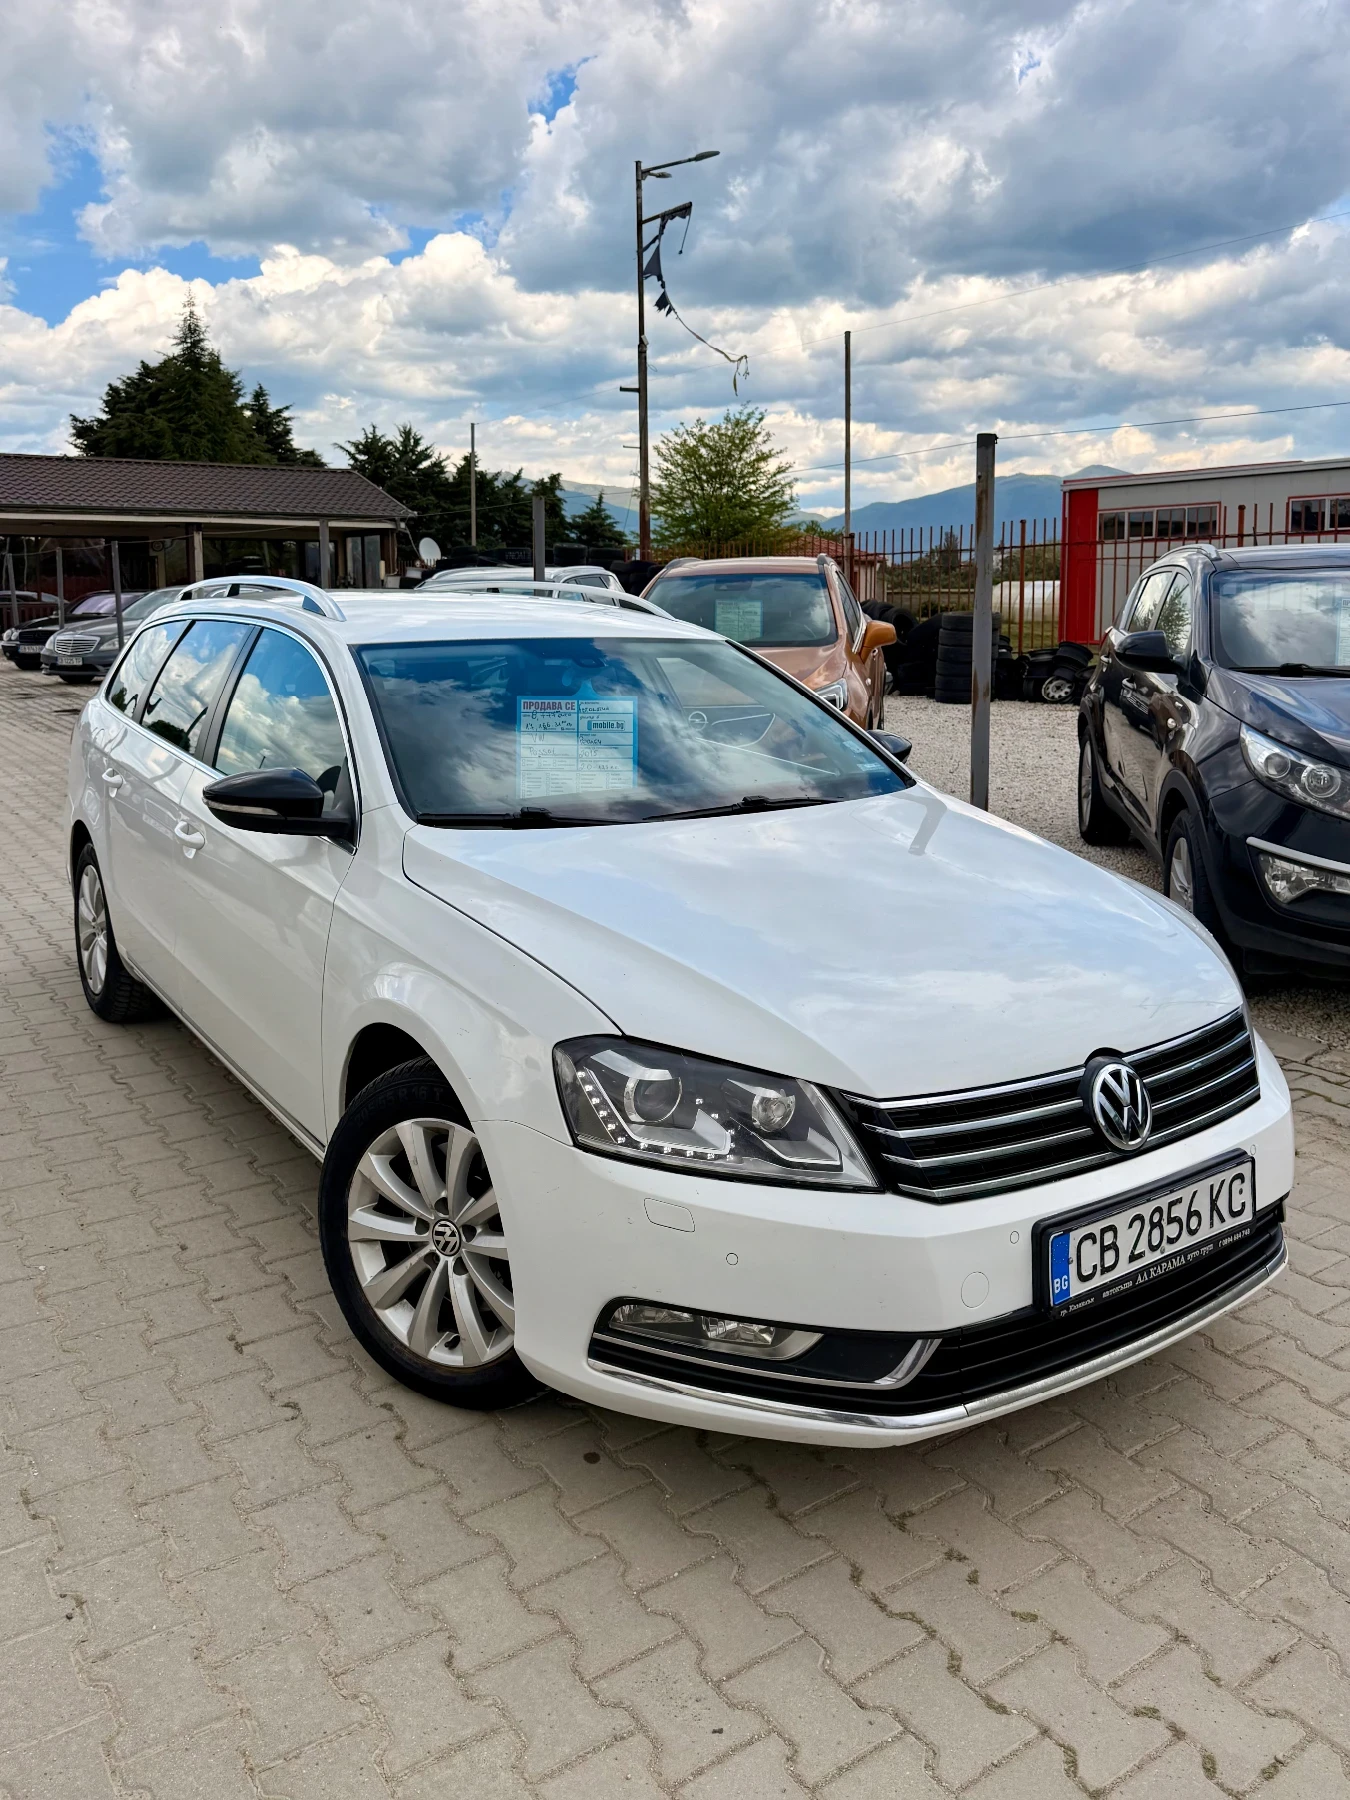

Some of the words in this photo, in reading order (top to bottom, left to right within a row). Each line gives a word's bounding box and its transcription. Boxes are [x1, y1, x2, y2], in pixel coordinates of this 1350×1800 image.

[523, 701, 562, 711] ПРОДАВА
[565, 701, 576, 711] СЕ
[592, 721, 625, 730] mobile.bg
[1076, 1224, 1120, 1283] CB
[1128, 1190, 1202, 1264] 2856
[1209, 1173, 1246, 1229] KC
[1149, 1254, 1186, 1279] КАРАМА
[1053, 1275, 1069, 1294] BG
